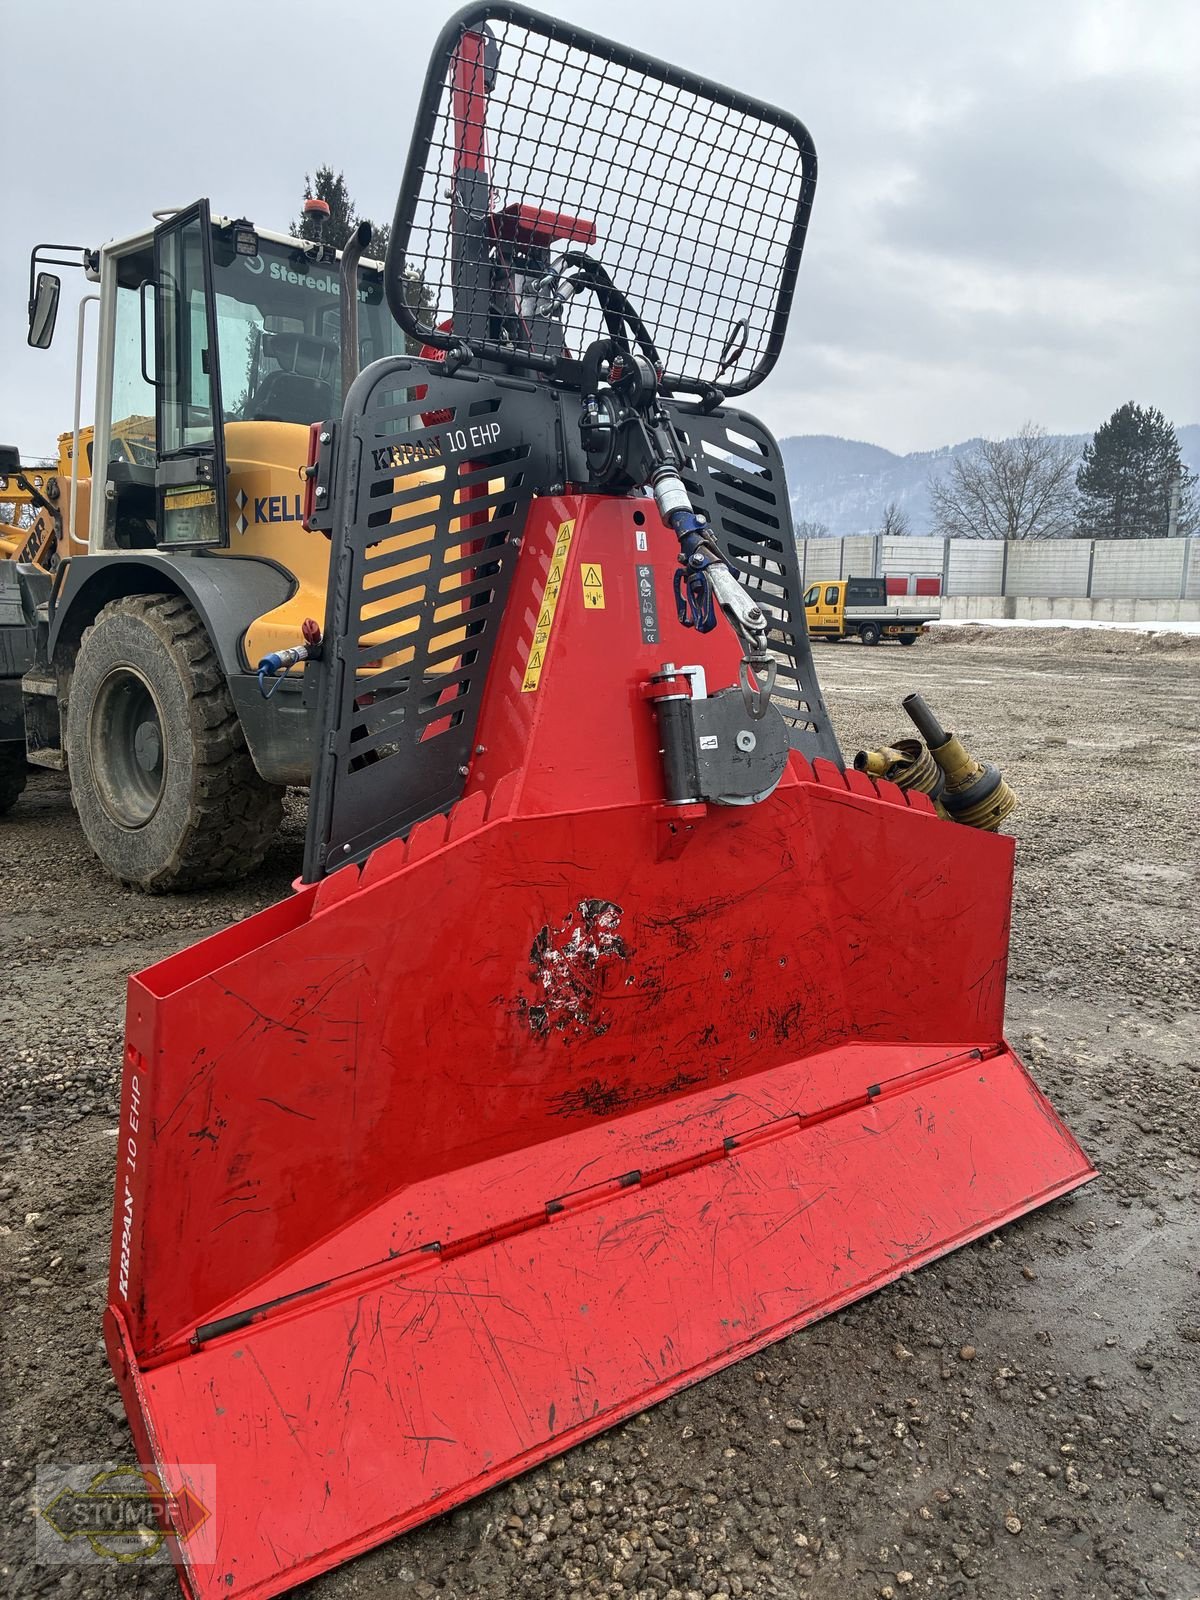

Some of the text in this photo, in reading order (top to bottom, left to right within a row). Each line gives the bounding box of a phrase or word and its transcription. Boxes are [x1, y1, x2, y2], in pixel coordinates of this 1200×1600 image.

[371, 422, 501, 471] KRPAN 10 EHP
[130, 1075, 141, 1134] EHP
[127, 1137, 137, 1173] 10
